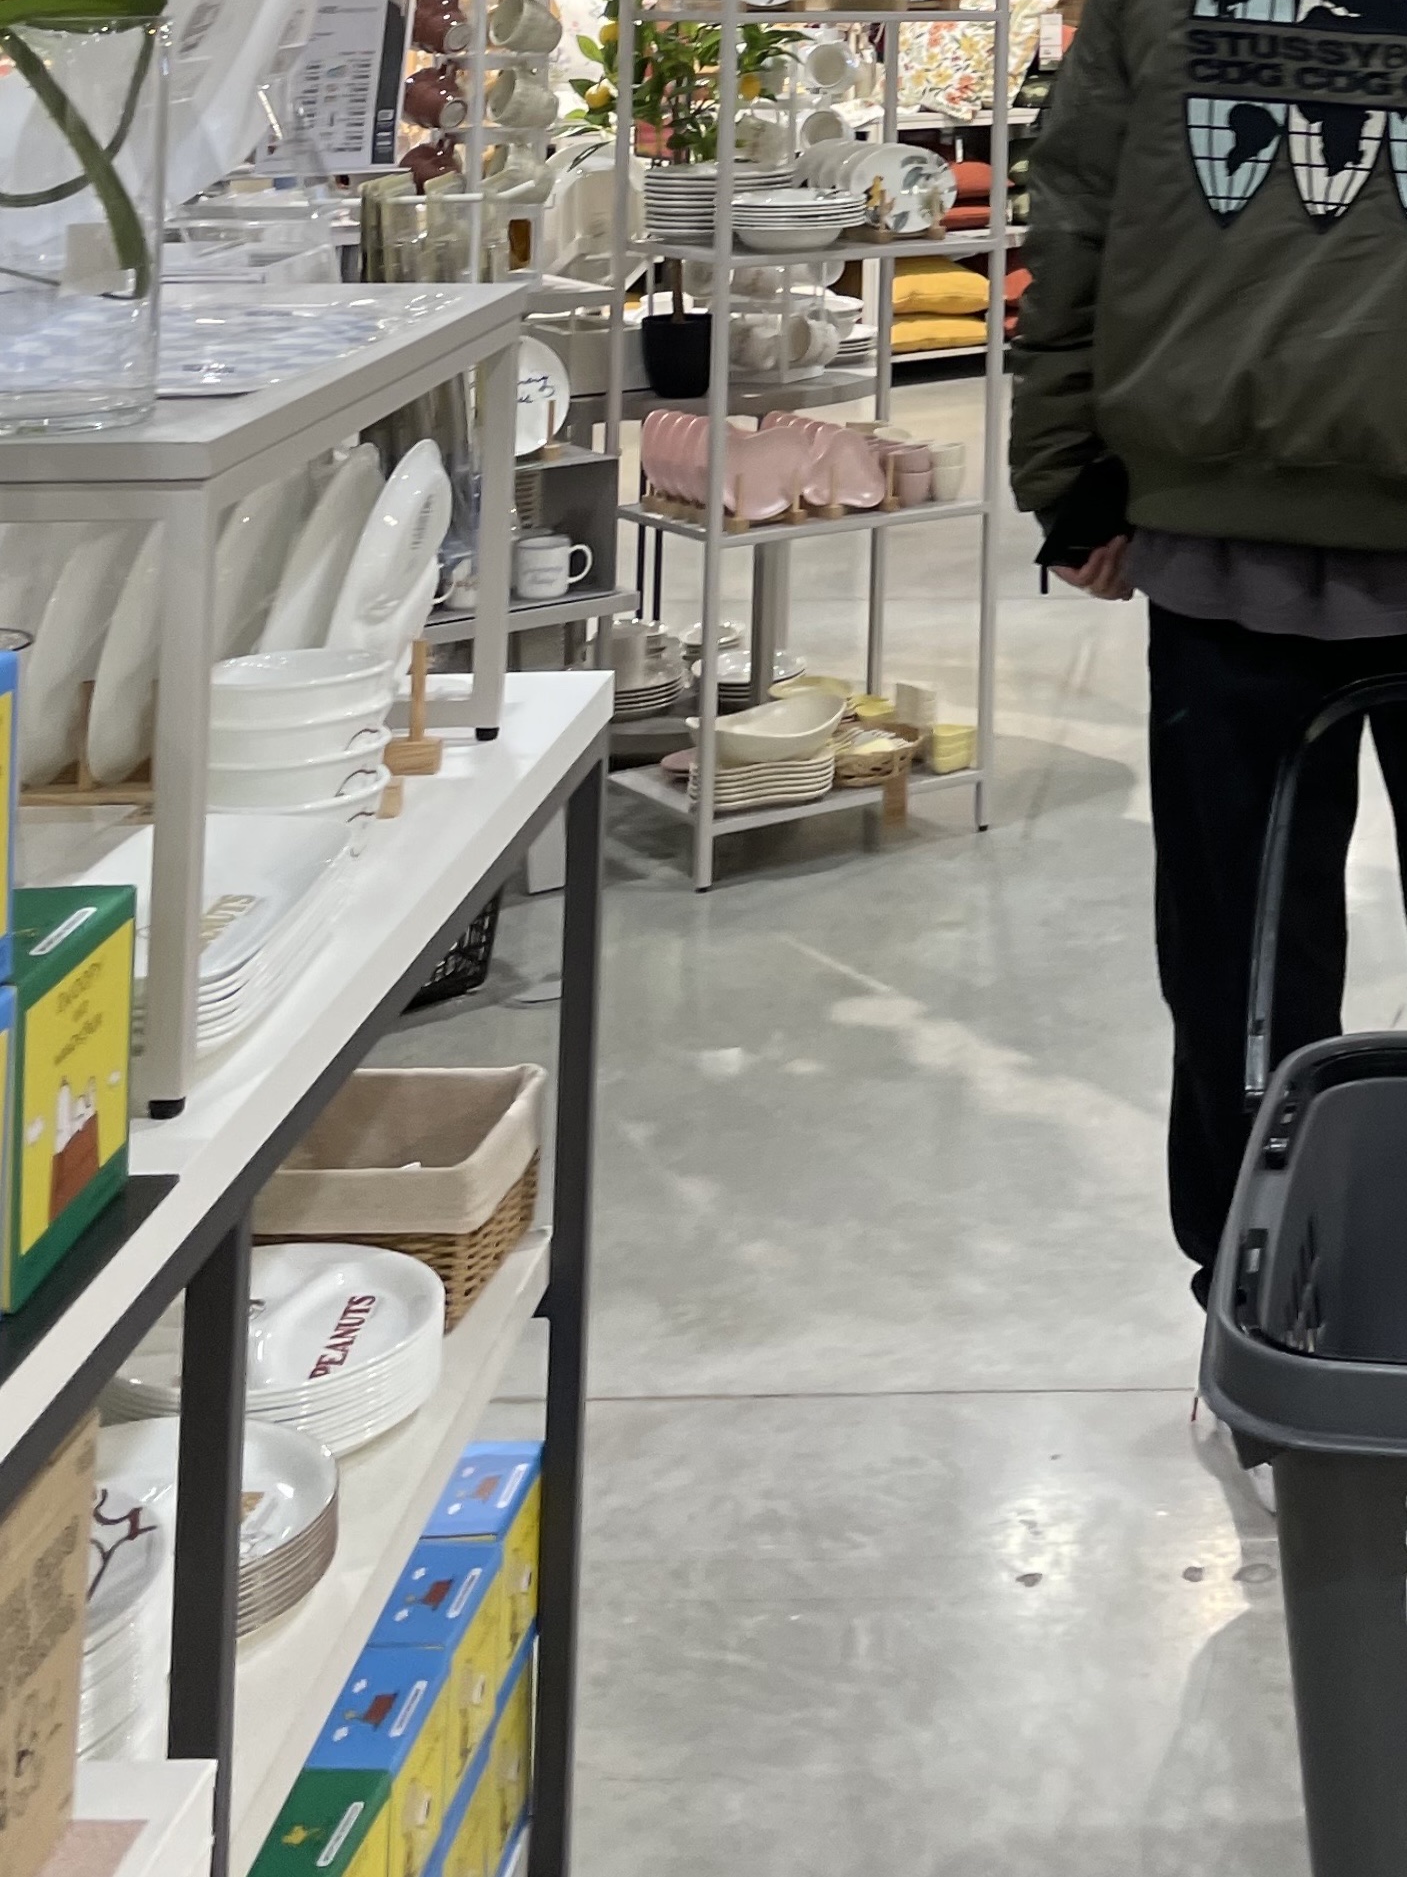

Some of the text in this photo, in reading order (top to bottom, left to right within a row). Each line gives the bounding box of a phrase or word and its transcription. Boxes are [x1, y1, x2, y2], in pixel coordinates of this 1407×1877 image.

[1188, 58, 1284, 87] CDG
[1295, 67, 1394, 96] CDG
[308, 1295, 376, 1379] PEANUTS
